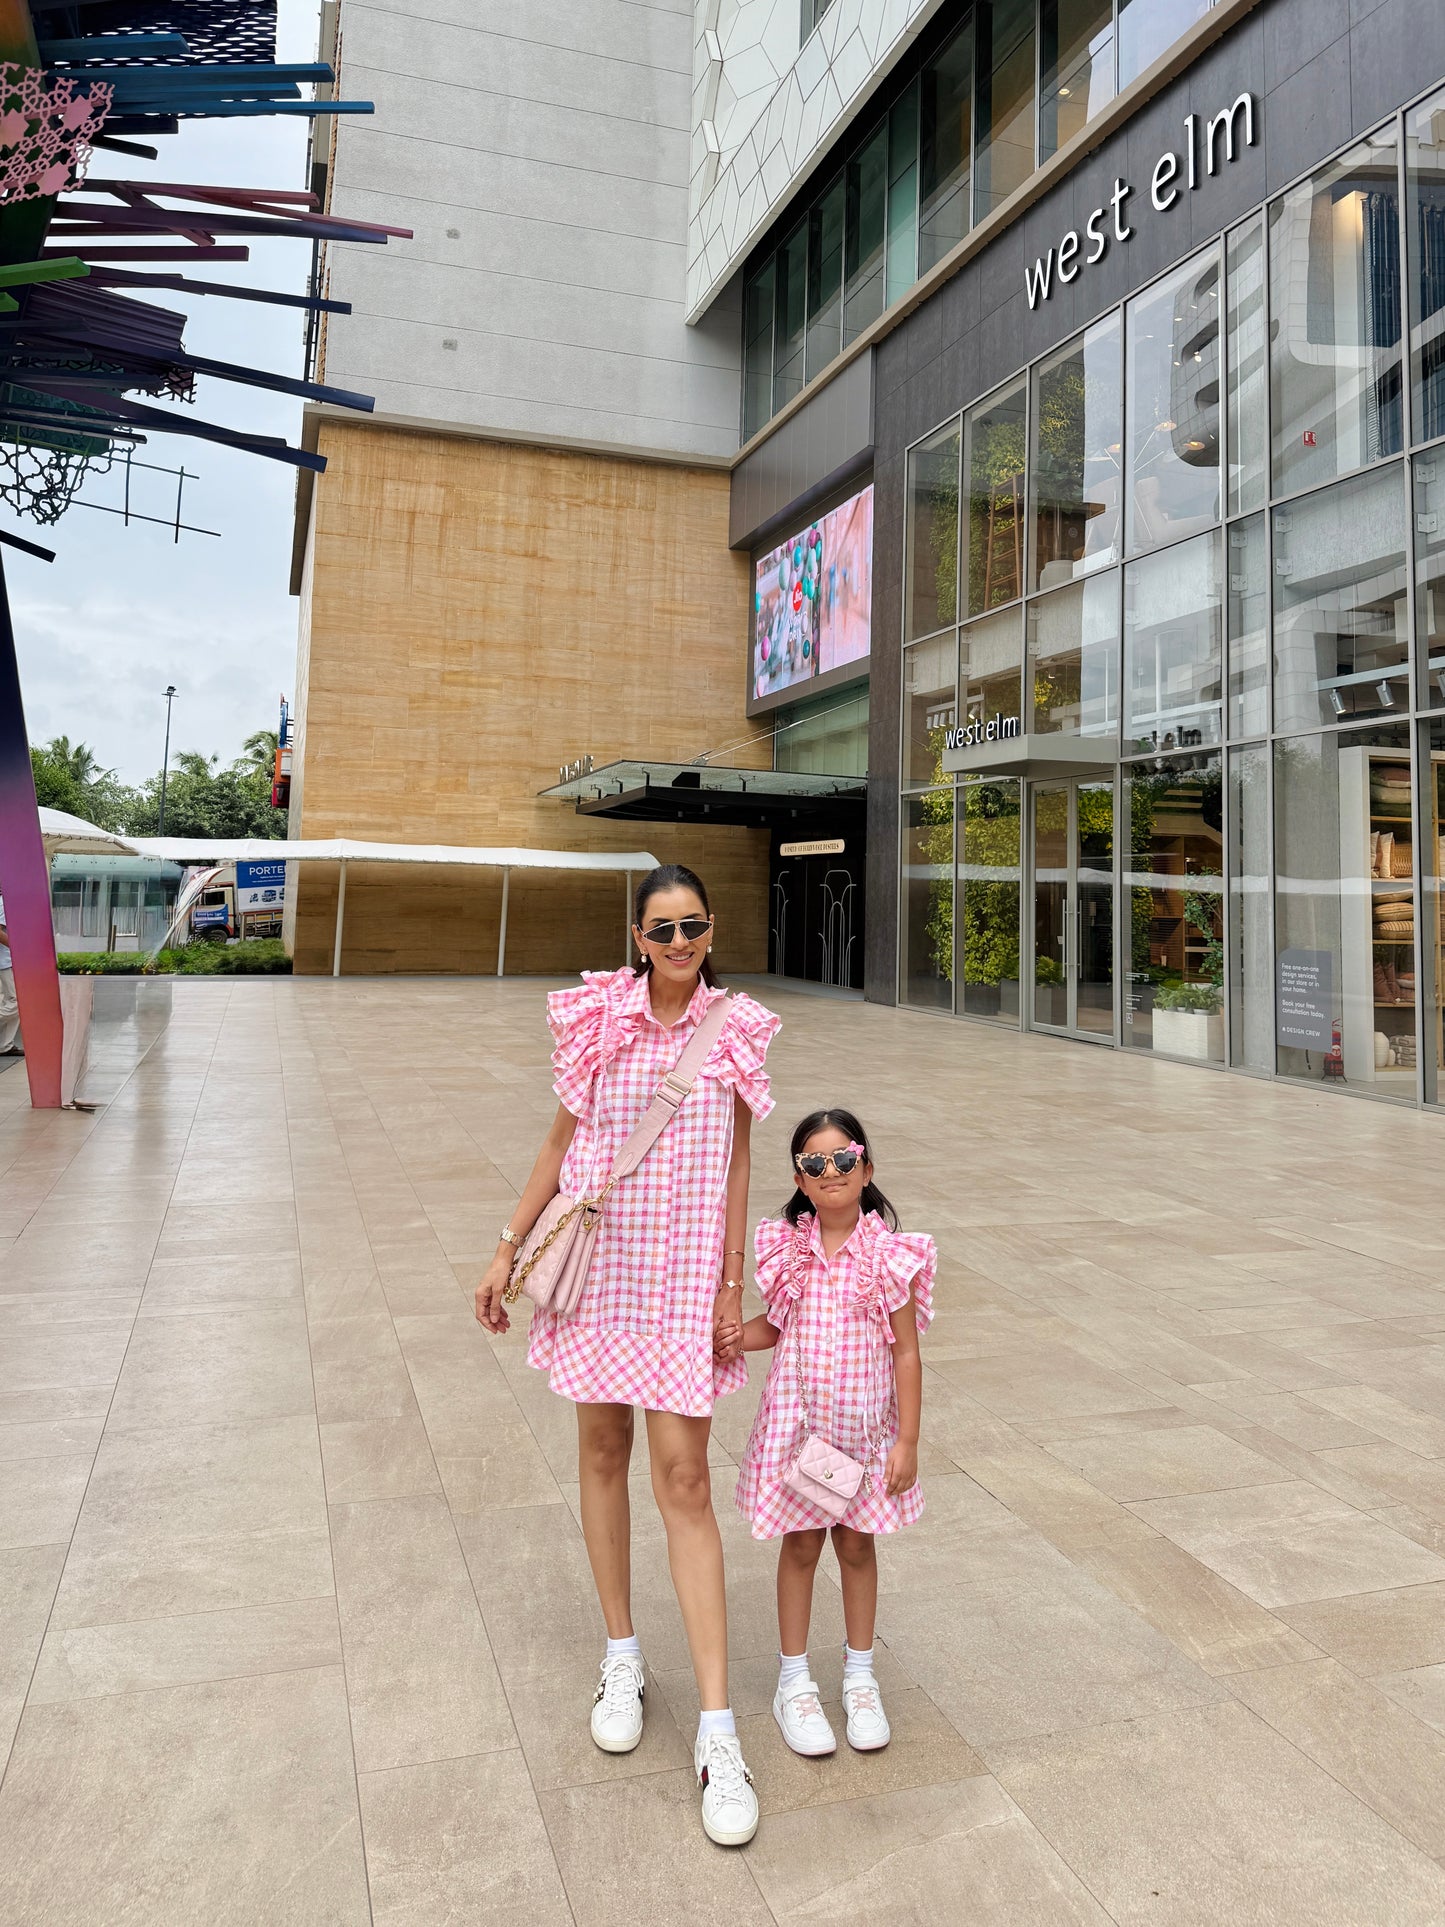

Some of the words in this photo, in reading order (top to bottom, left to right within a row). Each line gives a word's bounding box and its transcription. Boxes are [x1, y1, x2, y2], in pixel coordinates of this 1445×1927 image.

[1024, 177, 1131, 310] west
[1151, 92, 1254, 211] elm
[945, 718, 981, 749] west
[986, 712, 1018, 741] elm
[249, 865, 286, 876] PORTE
[1282, 970, 1297, 979] design
[1282, 999, 1294, 1007] Book
[1286, 1027, 1305, 1035] DESIGN
[1305, 1029, 1321, 1037] CREW
